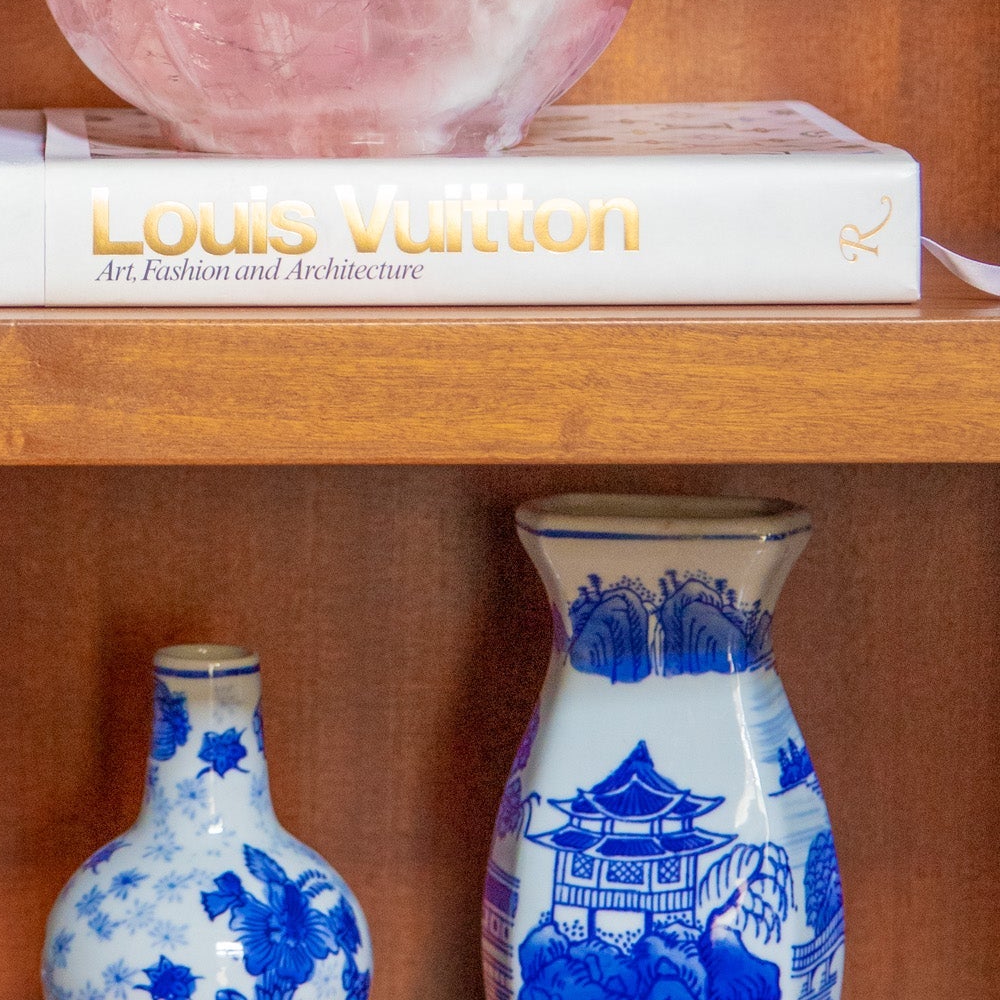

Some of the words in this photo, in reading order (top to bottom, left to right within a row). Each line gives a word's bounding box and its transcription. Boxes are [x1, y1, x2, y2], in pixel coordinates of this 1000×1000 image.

[91, 185, 318, 256] Louis
[334, 183, 640, 254] Vuitton
[94, 258, 138, 284] Art,
[140, 258, 234, 282] Fashion
[235, 257, 280, 281] and
[284, 256, 425, 281] Architecture
